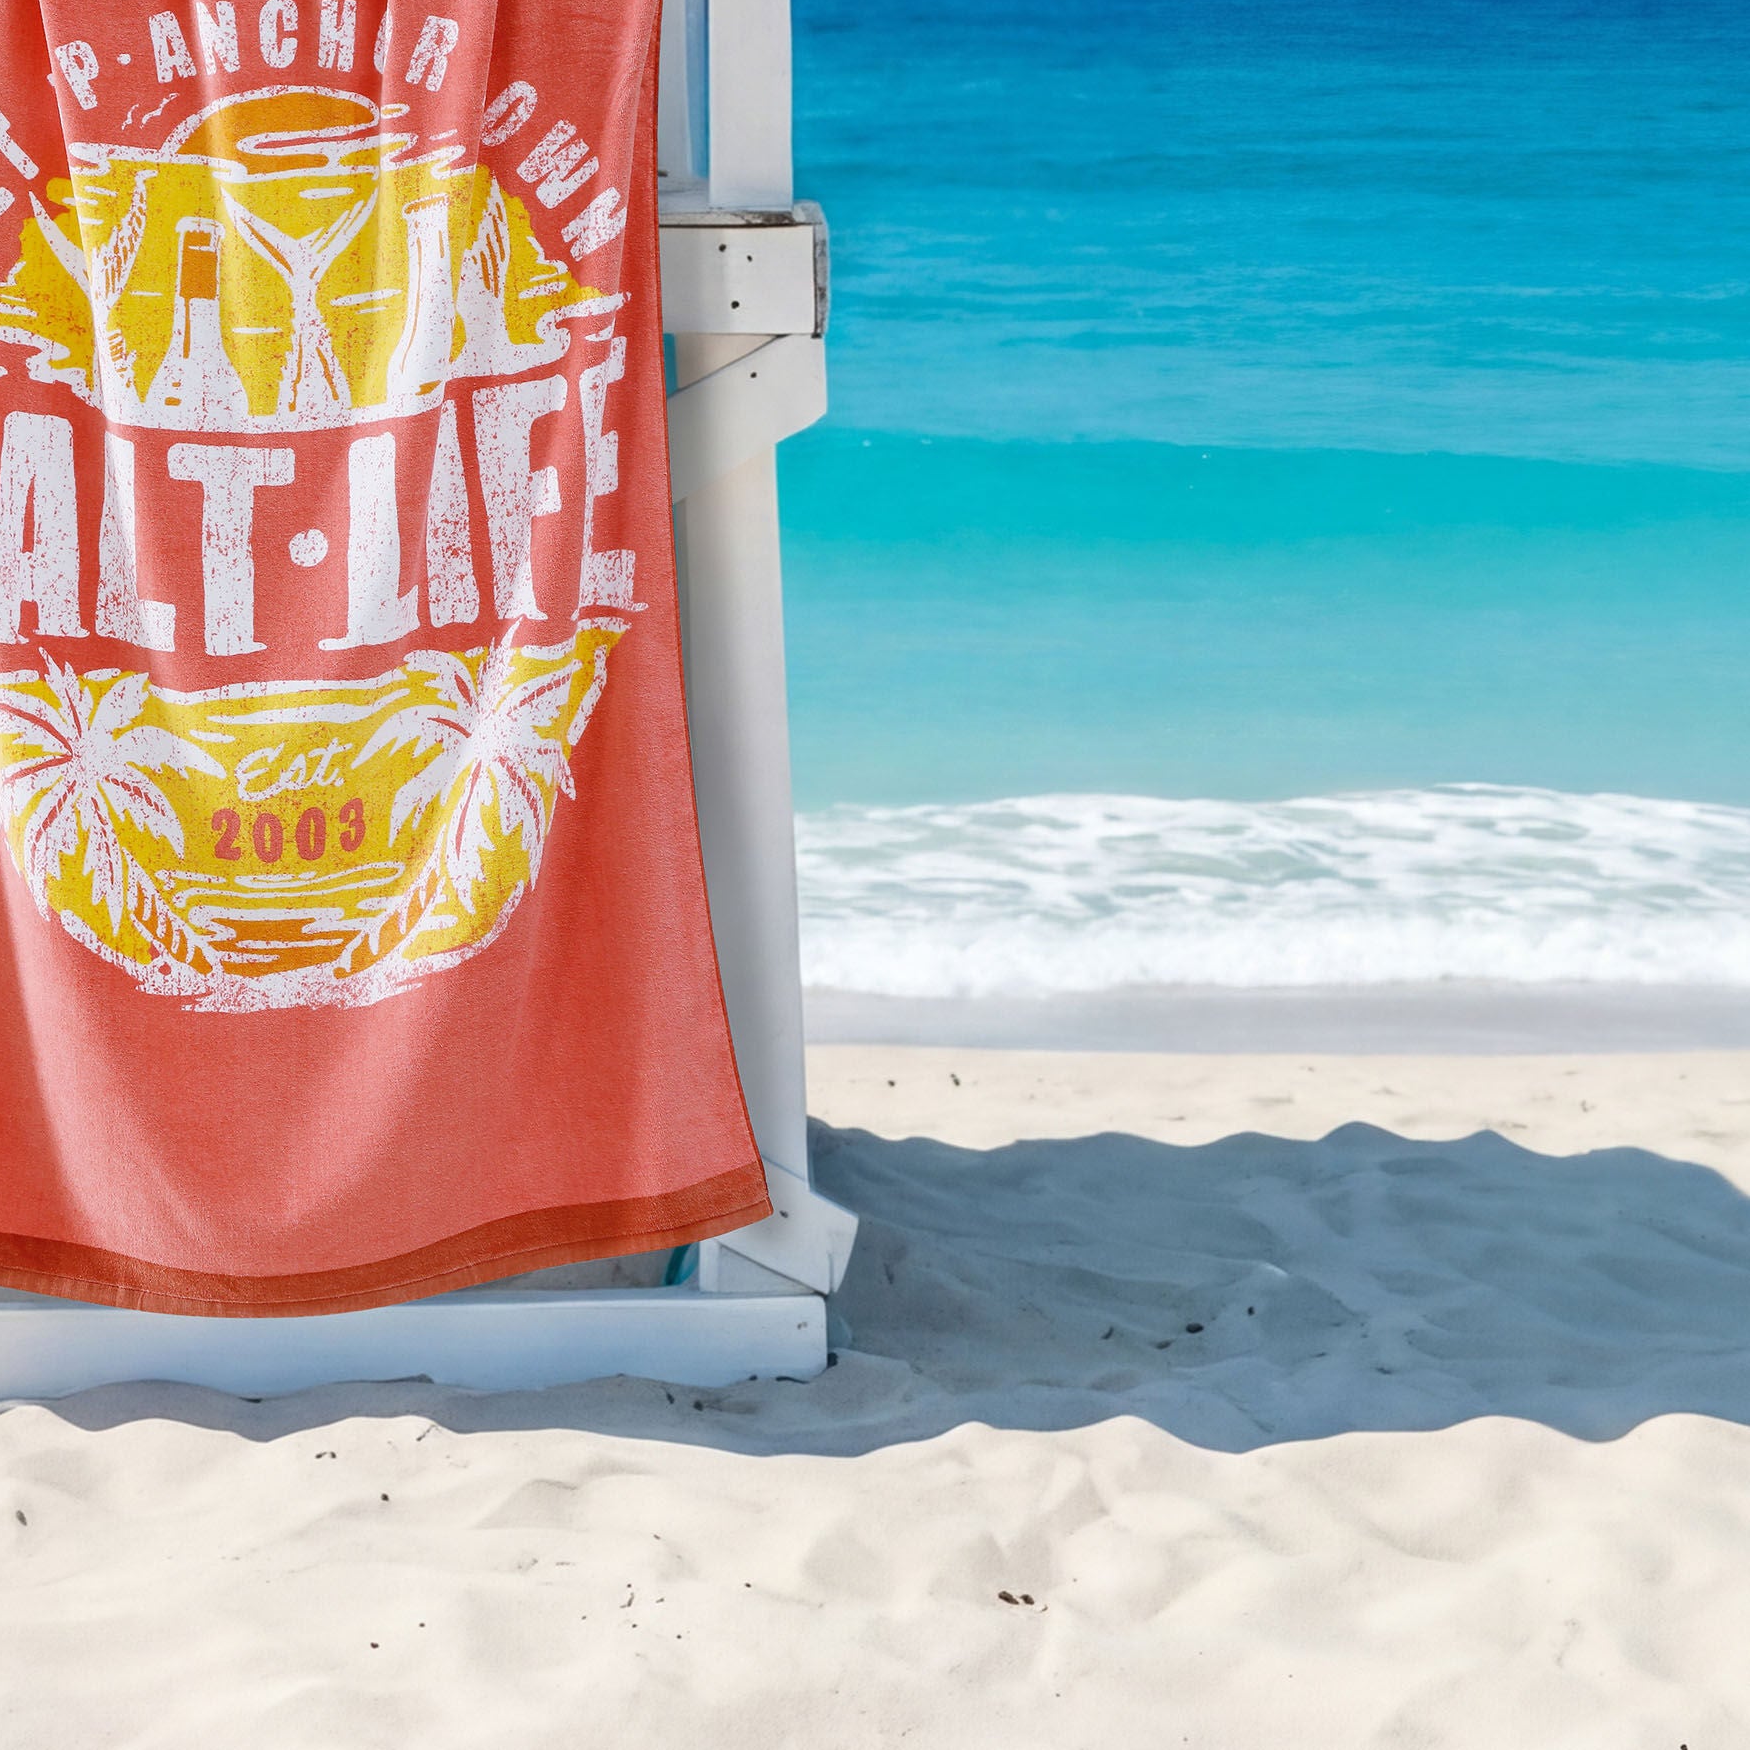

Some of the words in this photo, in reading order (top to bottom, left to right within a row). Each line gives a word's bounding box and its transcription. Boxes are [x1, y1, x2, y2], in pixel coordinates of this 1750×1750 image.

[47, 40, 99, 110] P
[480, 81, 628, 262] OWN
[318, 336, 649, 651] LIFE
[211, 797, 367, 864] 2003
[234, 737, 354, 802] Est.
